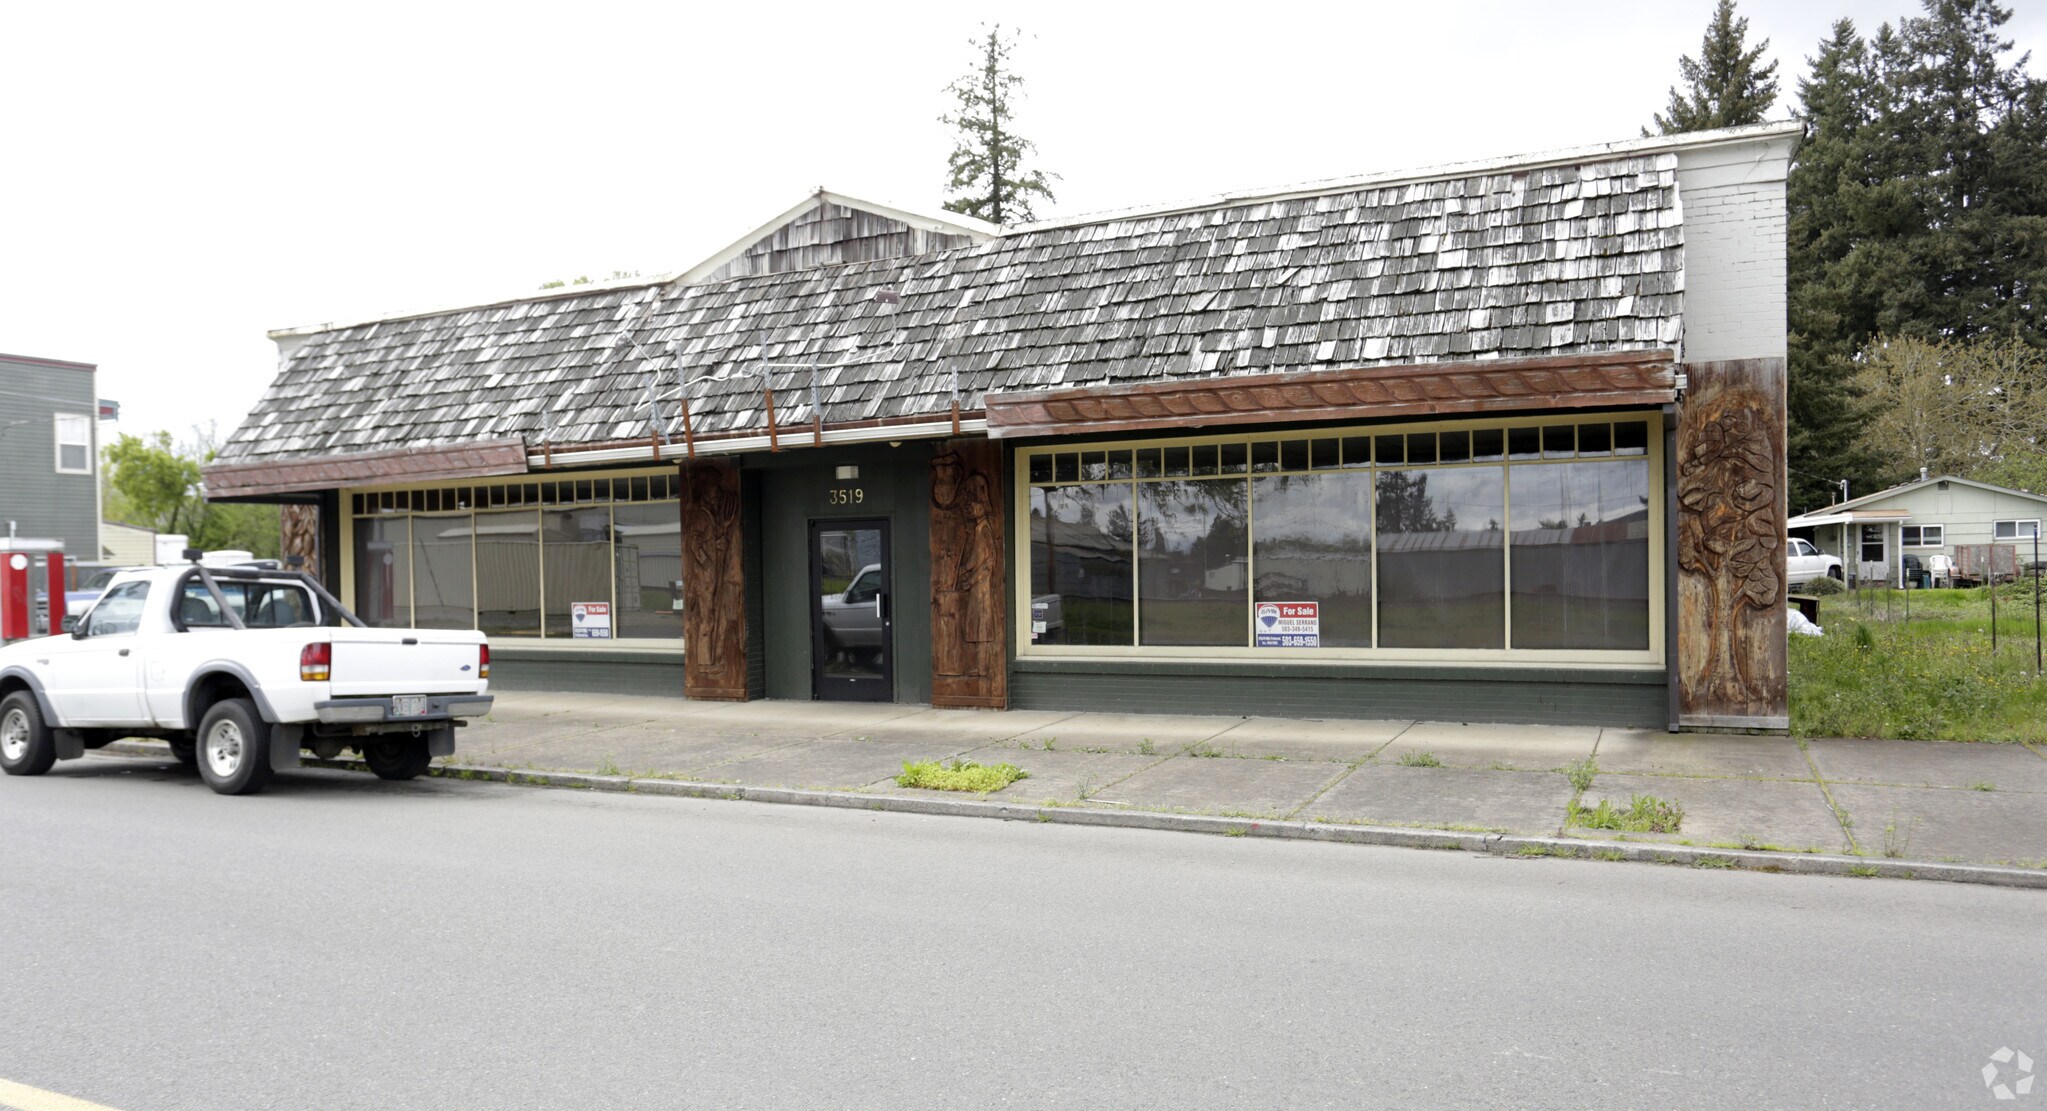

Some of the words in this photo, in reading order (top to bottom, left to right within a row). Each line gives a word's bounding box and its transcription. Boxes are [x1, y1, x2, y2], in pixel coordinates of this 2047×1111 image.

[830, 489, 863, 504] 3519
[1283, 607, 1296, 615] For
[1297, 606, 1314, 615] Sale
[1282, 636, 1317, 646] 503-659-1550
